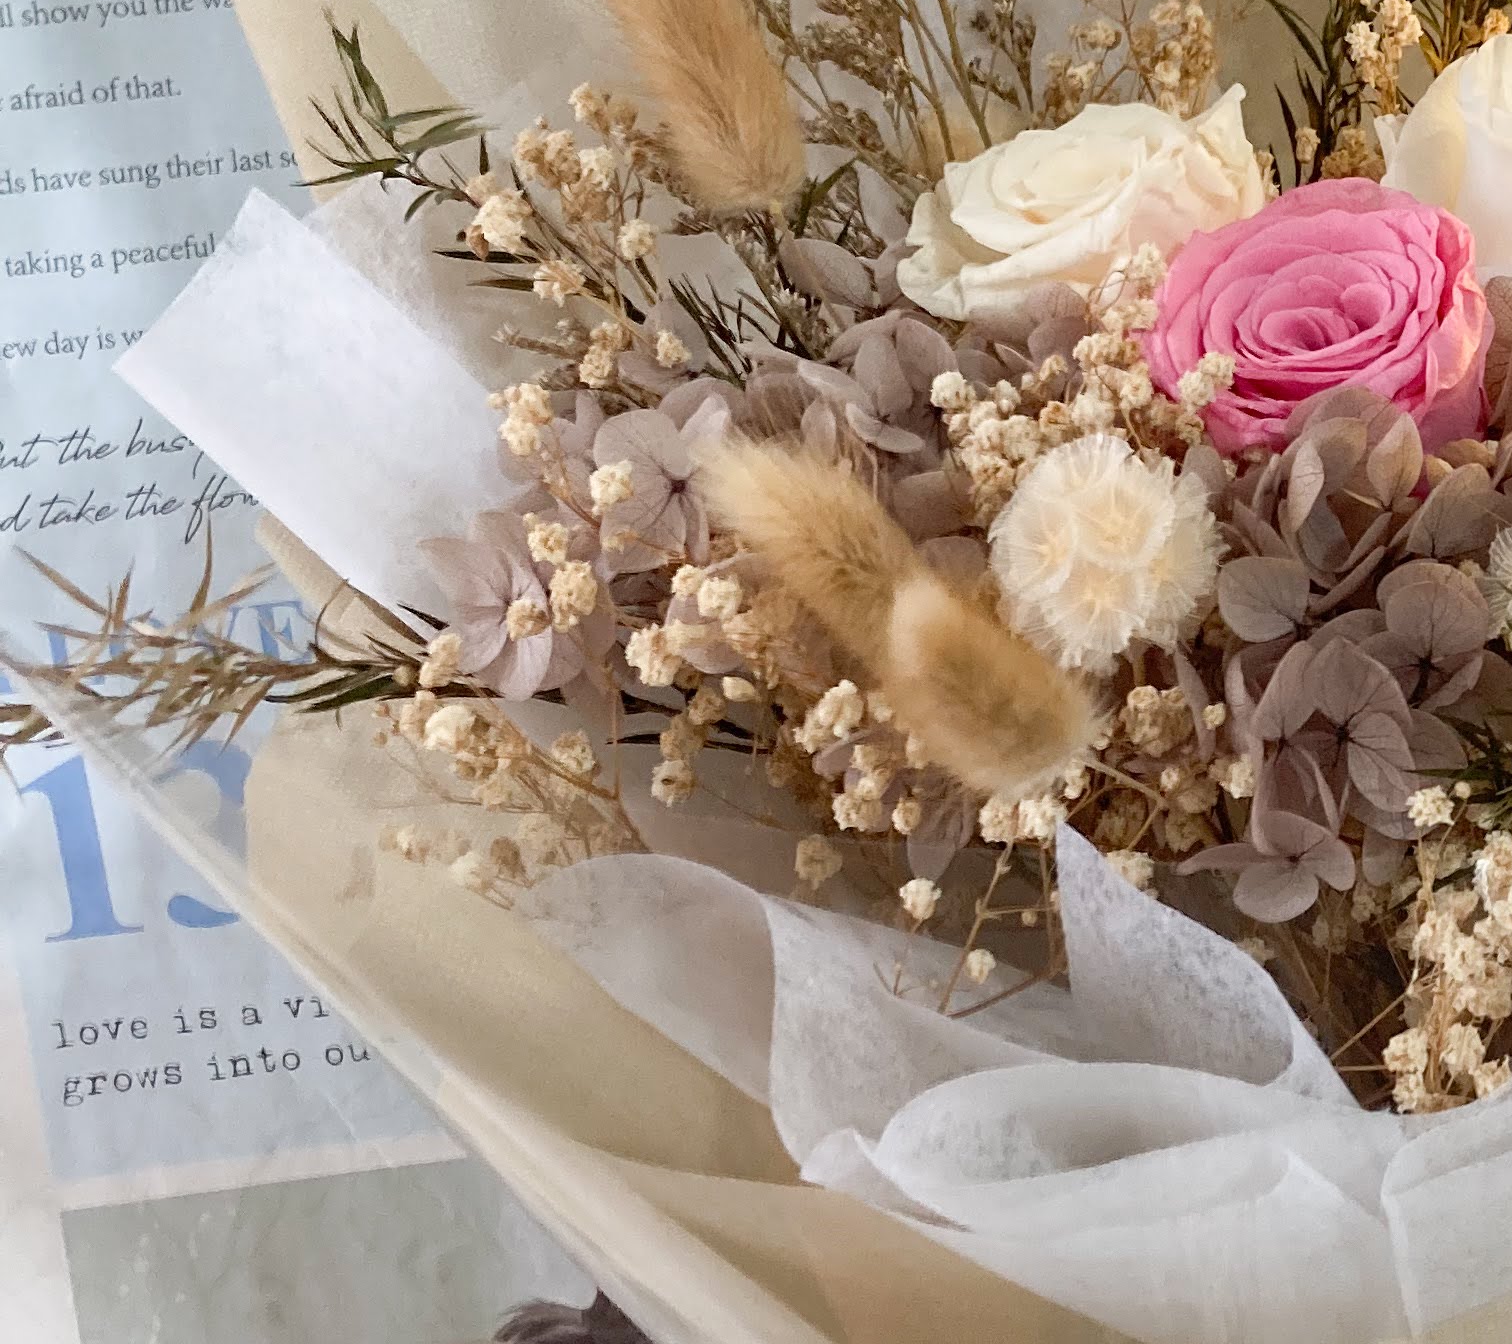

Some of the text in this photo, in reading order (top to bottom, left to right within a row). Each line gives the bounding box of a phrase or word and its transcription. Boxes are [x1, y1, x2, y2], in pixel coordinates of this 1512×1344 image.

[22, 0, 90, 27] show
[97, 0, 147, 27] you
[10, 80, 83, 111] afraid
[92, 76, 120, 103] of
[125, 74, 182, 99] that.
[31, 167, 91, 194] have
[100, 161, 161, 188] sung
[166, 150, 224, 179] their
[231, 148, 273, 173] last
[5, 233, 216, 278] taking a peaceful
[44, 331, 89, 359] day
[96, 324, 116, 352] is
[58, 425, 120, 465] the
[39, 488, 119, 529] take
[125, 483, 184, 520] the
[51, 996, 330, 1049] love is a vi
[63, 1042, 371, 1107] grows into ou
